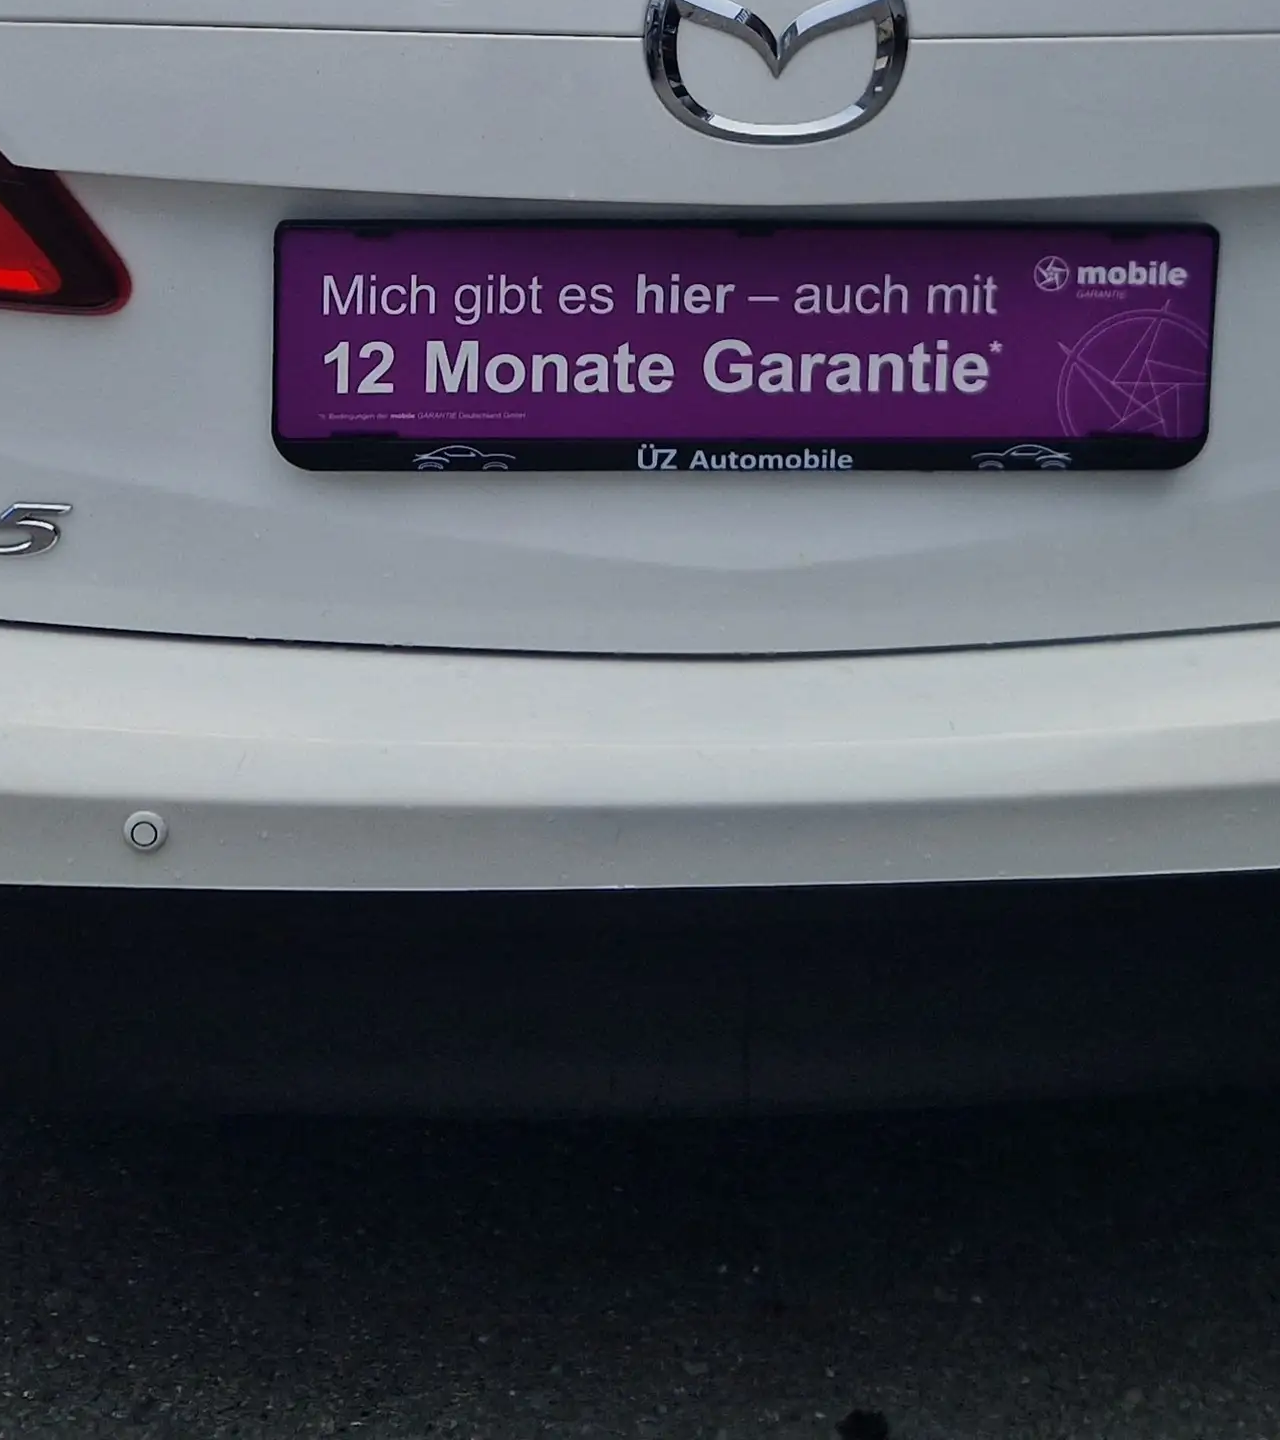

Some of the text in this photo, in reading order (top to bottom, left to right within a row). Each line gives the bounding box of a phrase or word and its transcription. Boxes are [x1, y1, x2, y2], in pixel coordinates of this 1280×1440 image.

[1077, 261, 1188, 286] mobile
[322, 274, 436, 316] Mich
[454, 274, 543, 325] gibt
[558, 282, 615, 315] es
[636, 273, 736, 315] hier
[794, 273, 909, 315] auch
[927, 274, 999, 315] mit
[1076, 289, 1127, 299] GARANTIE
[323, 341, 395, 394] 12
[425, 340, 675, 394] Monate
[637, 443, 854, 470] ÜZ Automobile
